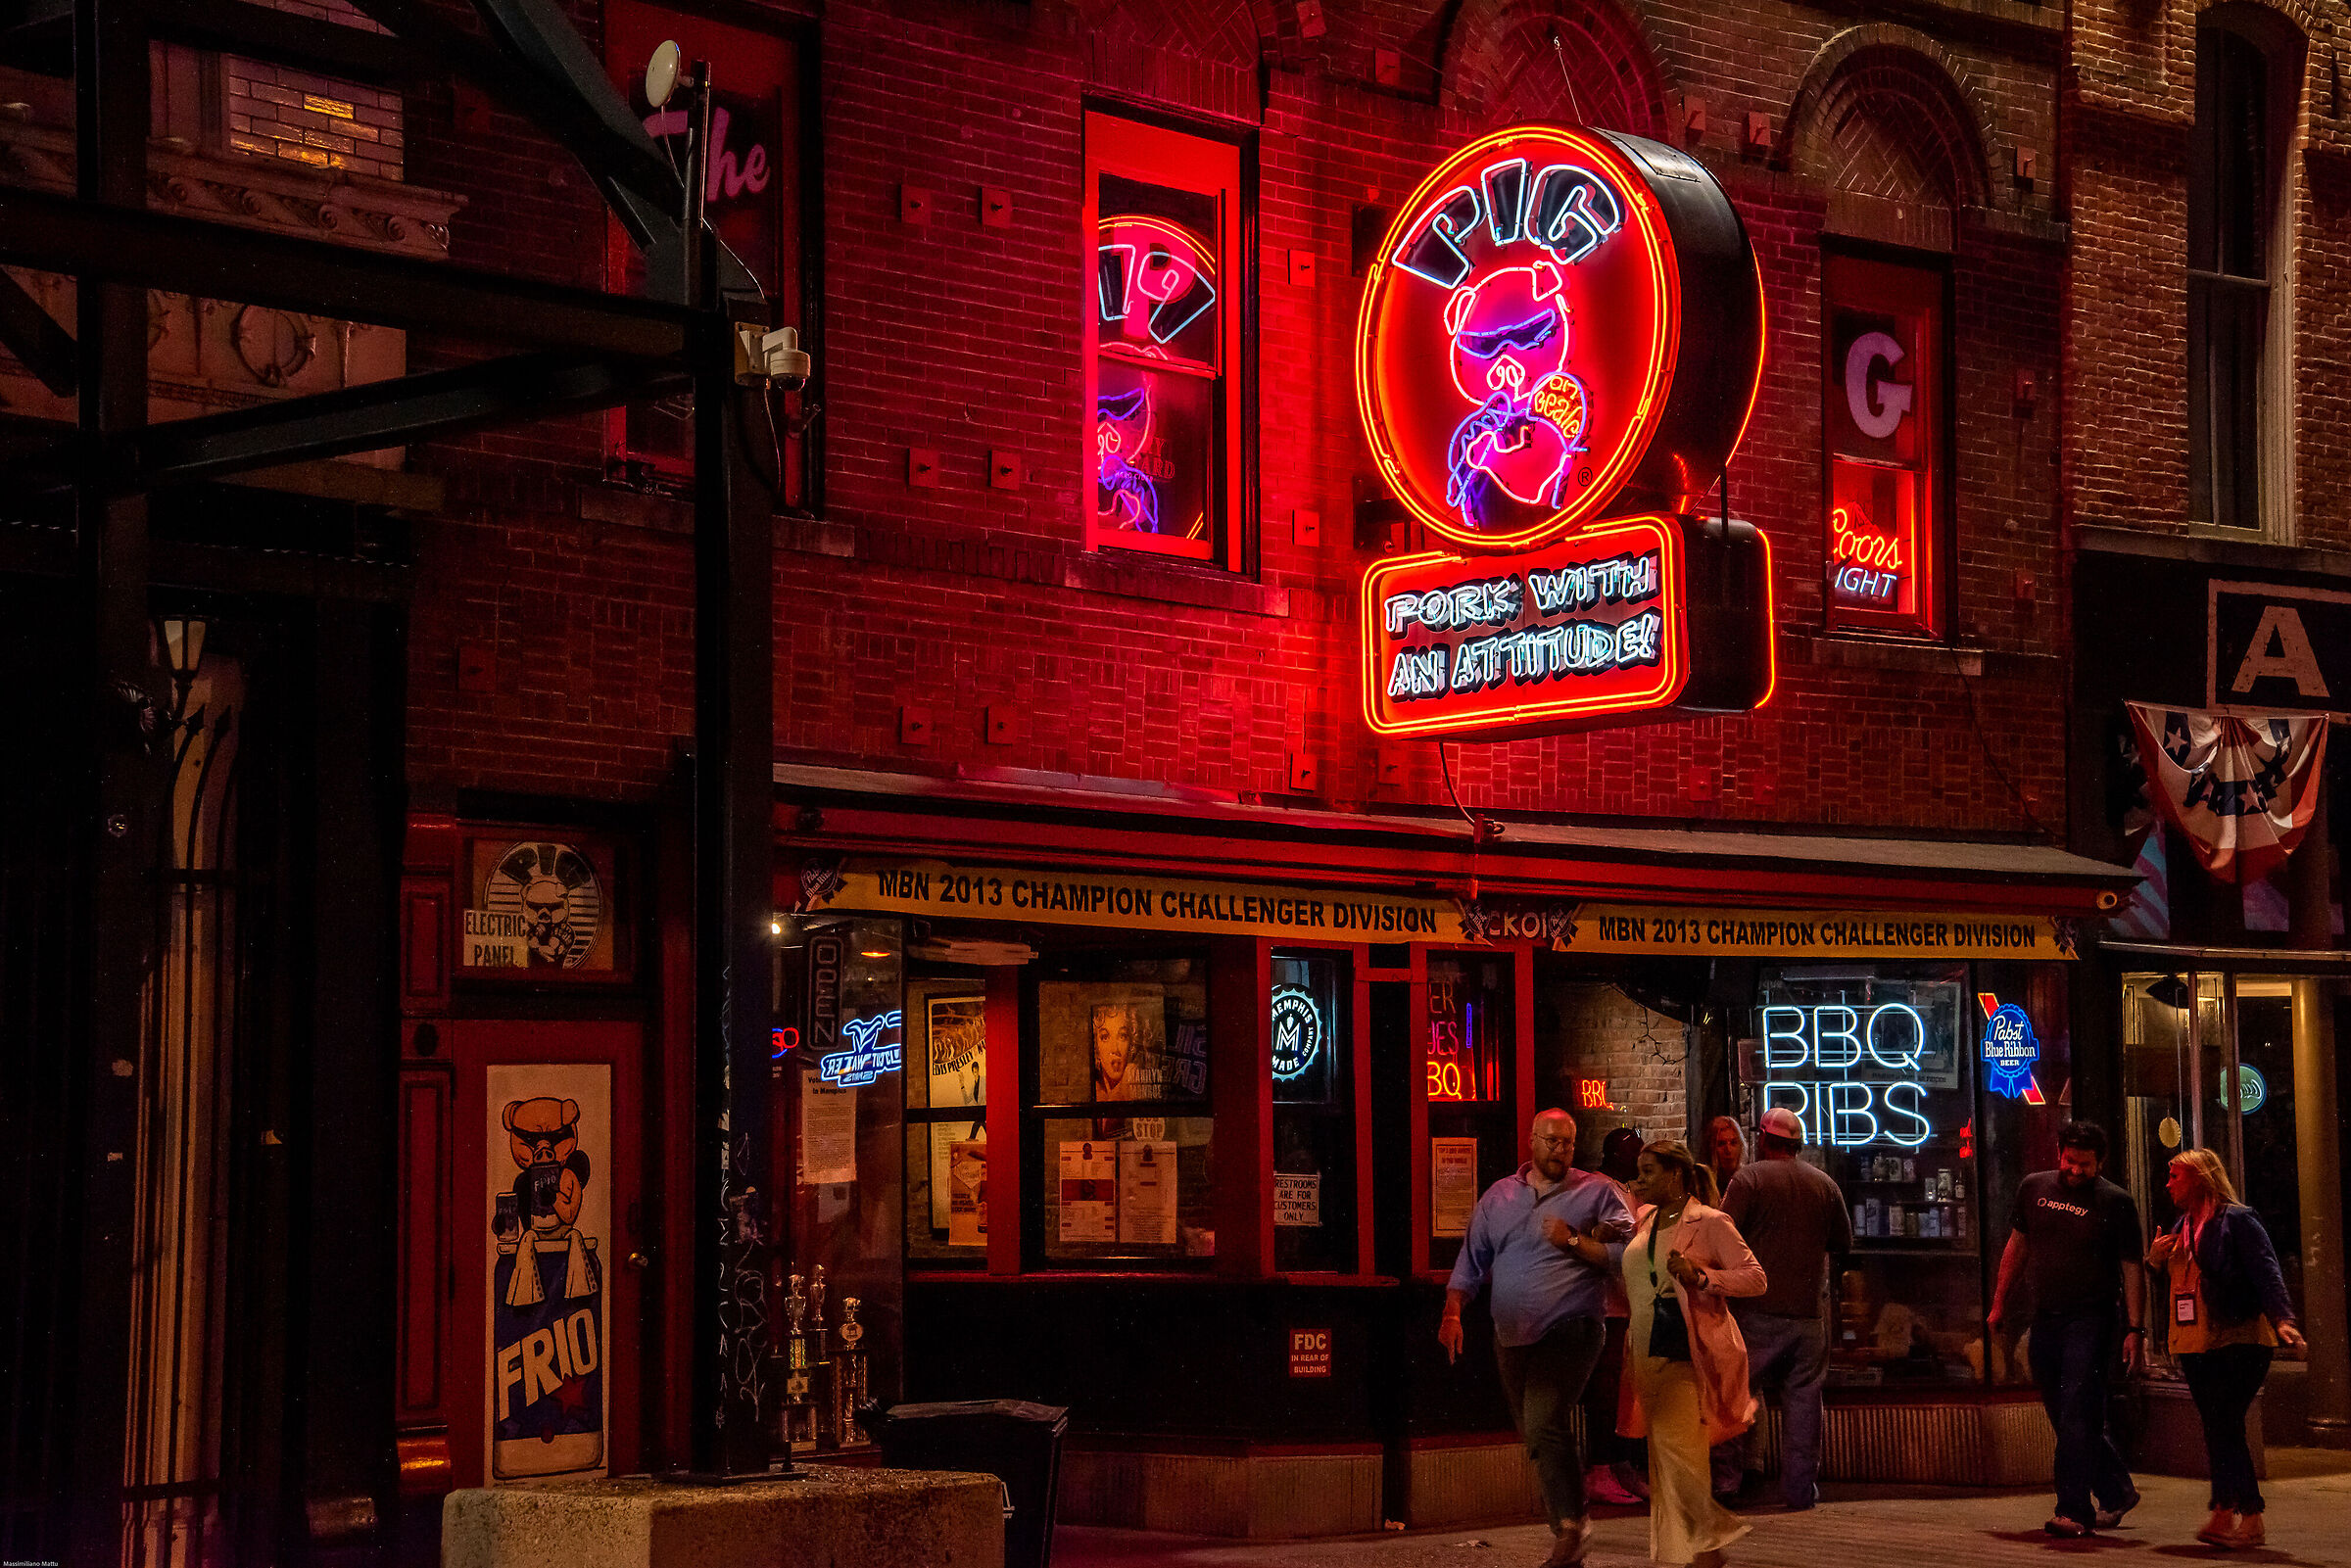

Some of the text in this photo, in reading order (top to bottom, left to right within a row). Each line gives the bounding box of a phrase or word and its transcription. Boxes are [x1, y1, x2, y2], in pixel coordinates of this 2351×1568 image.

[1391, 157, 1626, 290] PIG
[1846, 331, 1912, 439] G
[1384, 555, 1653, 634] PORK WITH
[1387, 613, 1655, 697] AN ATTITUDE!
[2231, 605, 2330, 698] A
[876, 869, 931, 901] MBN
[939, 875, 1003, 906] 2013
[1012, 879, 1152, 917] CHAMPION
[1161, 890, 1325, 927] CHALLENGER
[1333, 902, 1437, 933] DIVISION
[464, 913, 527, 937] ELECTRIC
[1599, 916, 1646, 942] MBN
[1653, 919, 1701, 943] 2013
[1706, 920, 1816, 946] CHAMPION
[1820, 921, 1948, 947] CHALLENGER
[1954, 924, 2036, 948] DIVISION
[1272, 999, 1314, 1024] MEMPHIS
[1763, 1003, 1926, 1071] BBQ
[1992, 1015, 2025, 1041] Pabst
[1302, 1026, 1314, 1057] COMPANY
[1985, 1041, 2036, 1058] Blue Ribbon
[947, 1050, 974, 1073] PRESLEY
[1272, 1055, 1300, 1071] MADE
[1763, 1081, 1931, 1146] RIBS
[1135, 1121, 1164, 1138] STOP
[1274, 1178, 1318, 1189] RESTROOMS
[1278, 1190, 1312, 1200] ARE FOR
[1273, 1201, 1317, 1211] CUSTOMERS
[1283, 1212, 1304, 1221] ONLY
[2047, 1200, 2089, 1217] apptegy
[1294, 1333, 1326, 1351] FDC
[498, 1307, 599, 1421] FRIO
[1291, 1354, 1299, 1362] IN
[1300, 1354, 1319, 1362] REAR
